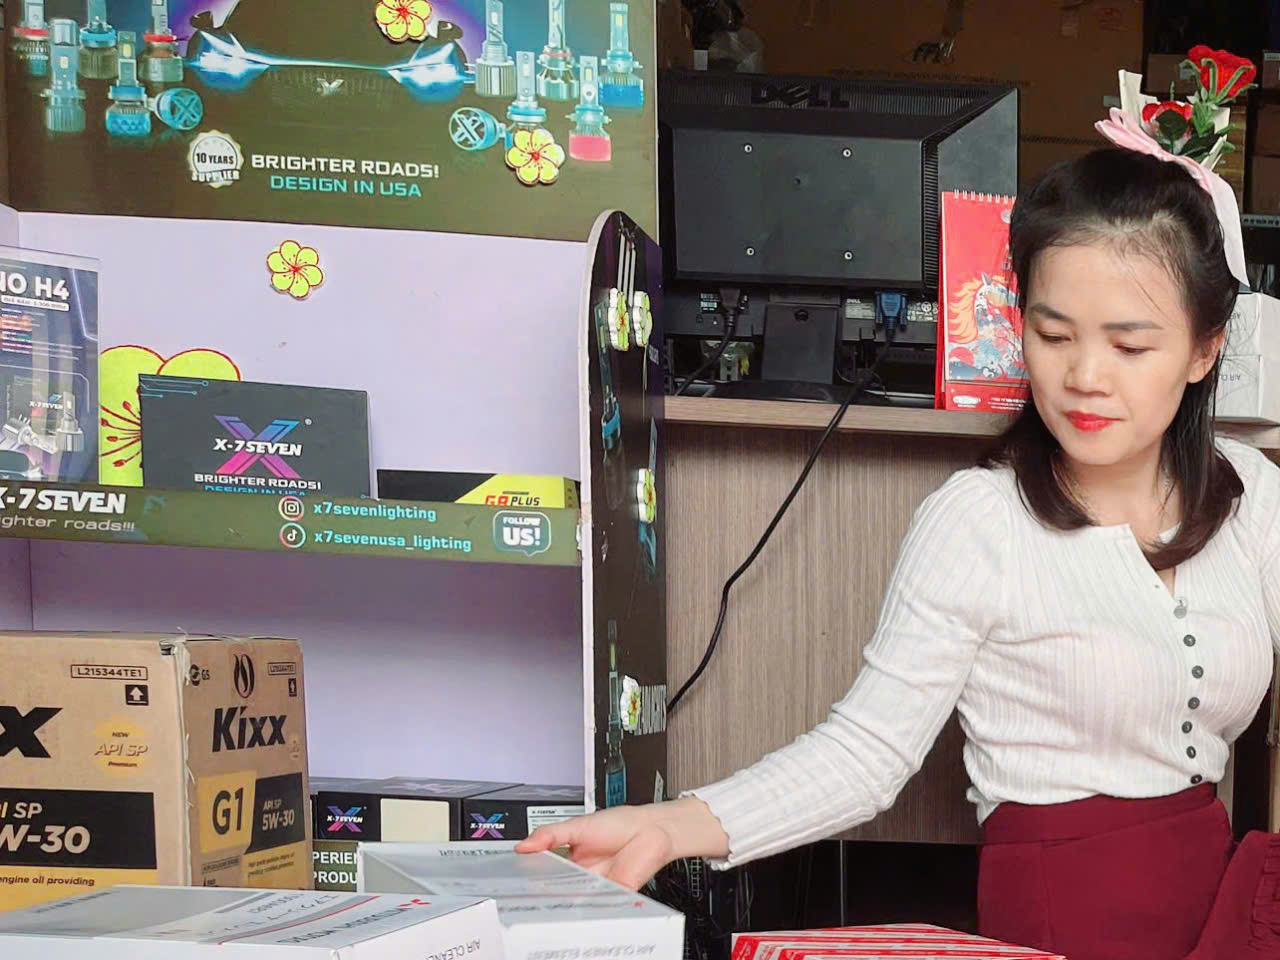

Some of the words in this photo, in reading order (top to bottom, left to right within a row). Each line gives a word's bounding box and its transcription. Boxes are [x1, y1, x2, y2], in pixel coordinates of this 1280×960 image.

[196, 152, 207, 164] 10
[208, 155, 234, 165] YEARS
[252, 154, 356, 173] BRIGHTER
[361, 160, 440, 180] ROADS!
[271, 174, 348, 193] DESIGN
[354, 180, 374, 194] IN
[380, 182, 422, 197] USA
[35, 275, 70, 301] H4
[214, 438, 303, 458] X-7SEVEN
[194, 474, 264, 488] BRIGHTER
[510, 496, 541, 507] PLUS
[313, 502, 437, 522] x7sevenlighting
[64, 517, 136, 537] roads!!!
[503, 527, 541, 547] US!
[315, 531, 473, 552] x7sevenusa_lighting
[77, 667, 142, 678] L215344TE1
[212, 706, 288, 753] Kixx
[13, 801, 43, 819] SP
[213, 788, 244, 836] G1
[262, 809, 295, 832] 5W-30
[48, 876, 95, 890] providing
[464, 939, 482, 956] AIR
